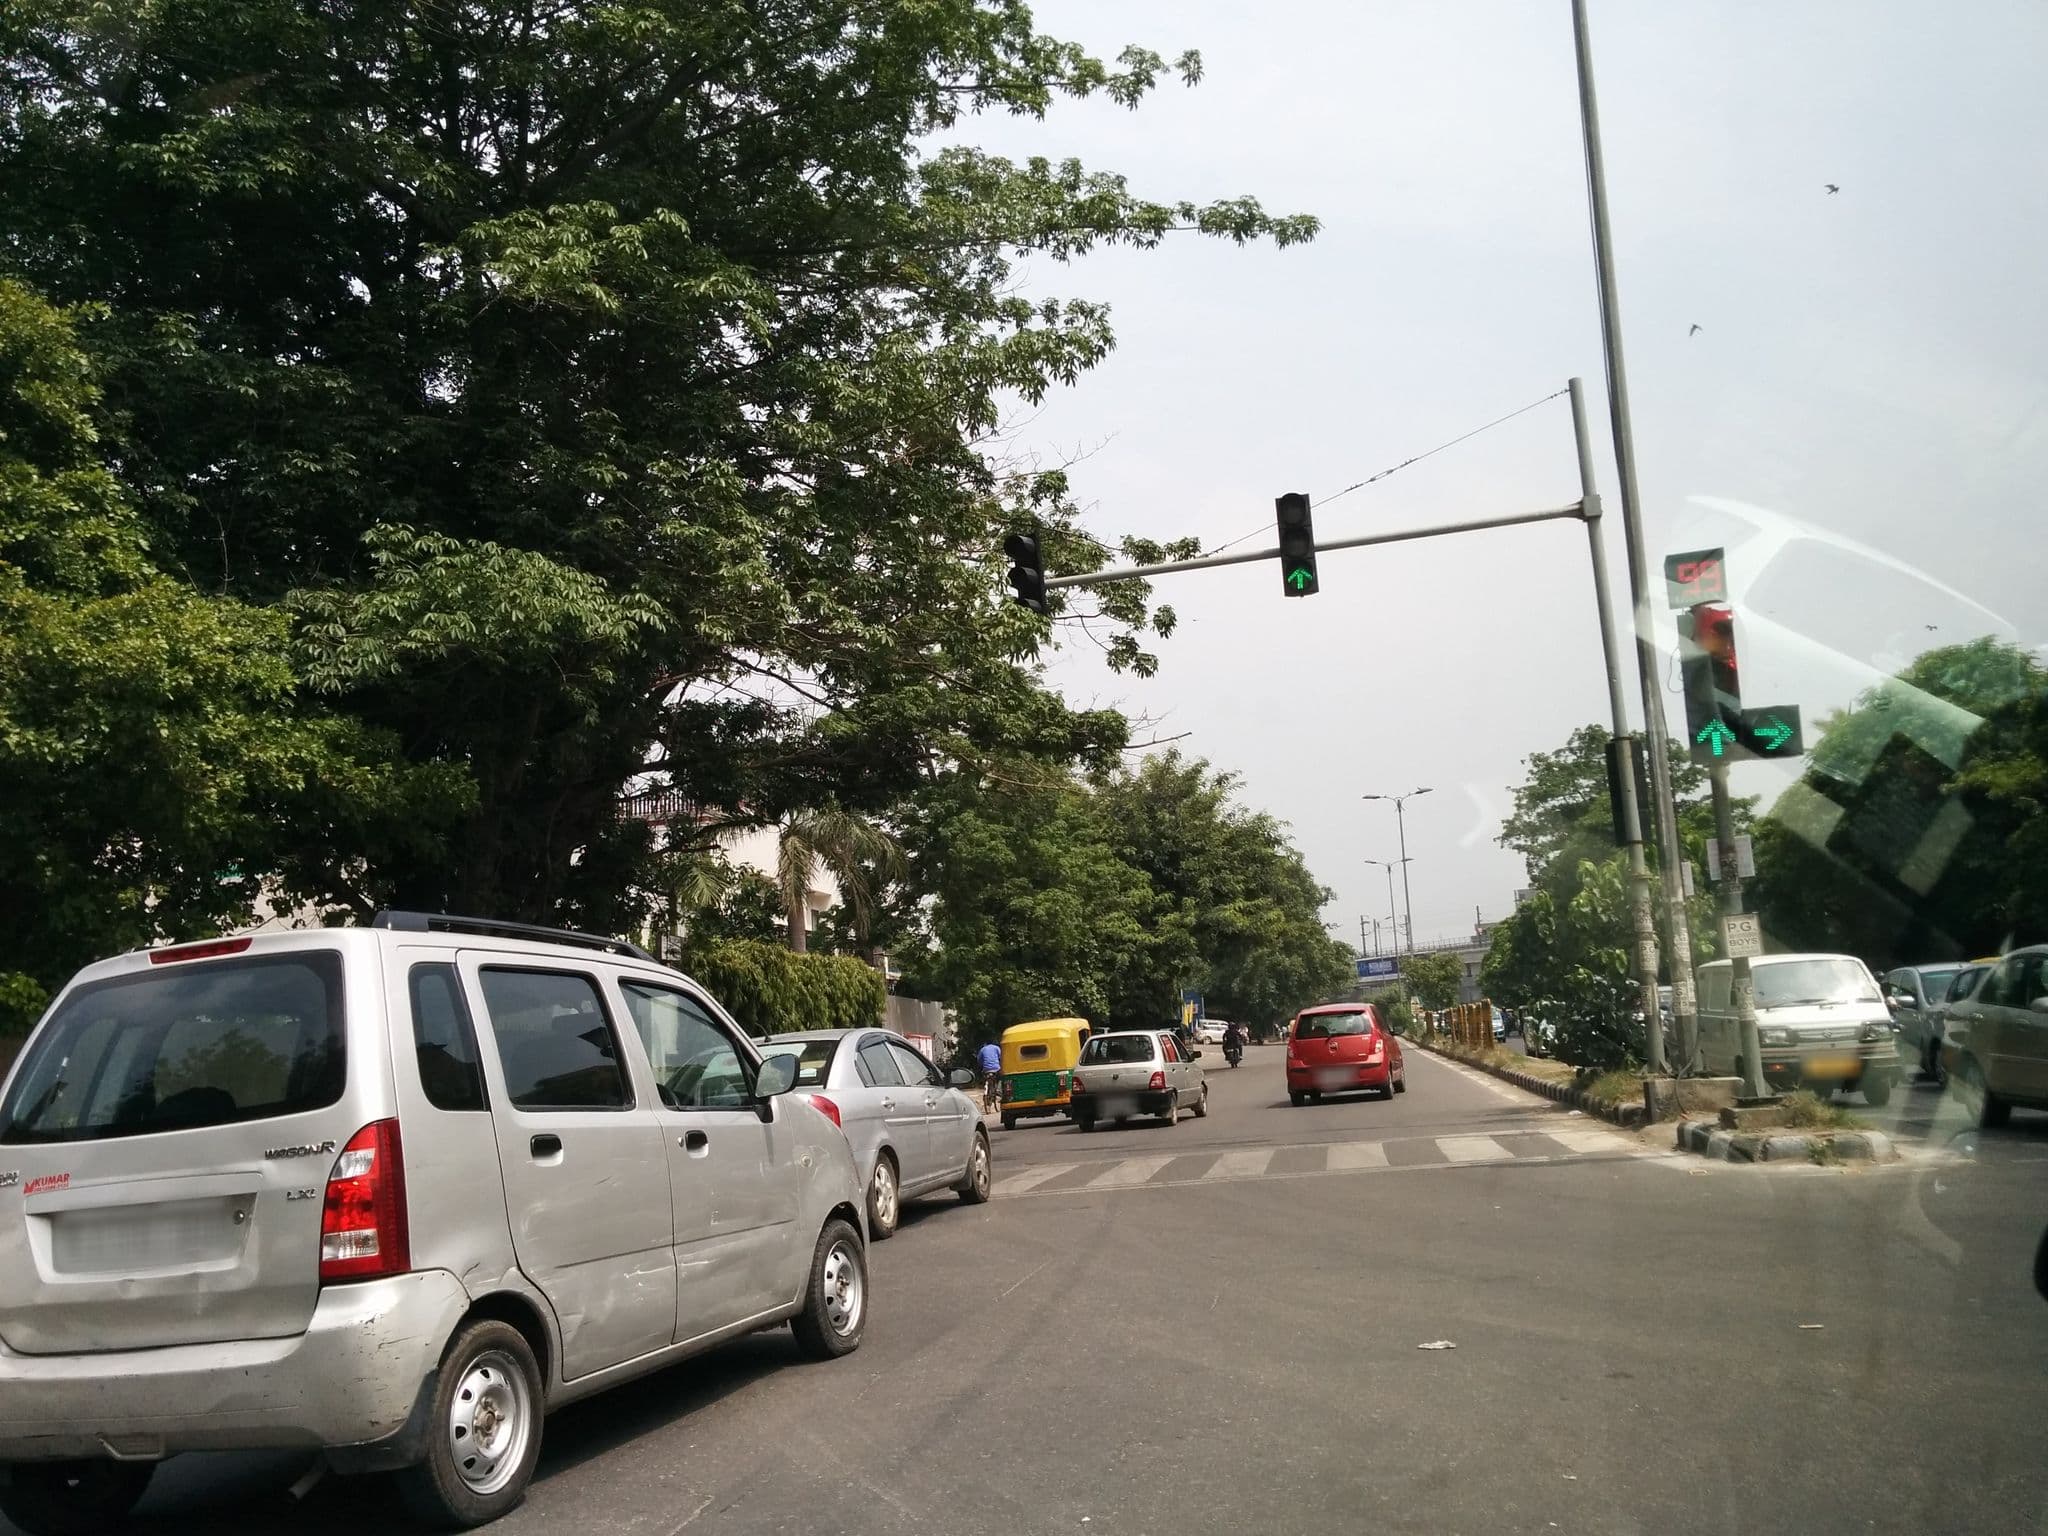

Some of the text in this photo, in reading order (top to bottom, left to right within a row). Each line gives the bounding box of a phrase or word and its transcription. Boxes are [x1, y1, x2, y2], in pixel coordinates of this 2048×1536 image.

[1676, 560, 1721, 596] 99
[1729, 937, 1758, 947] BOYS
[33, 1173, 70, 1187] KUMAR
